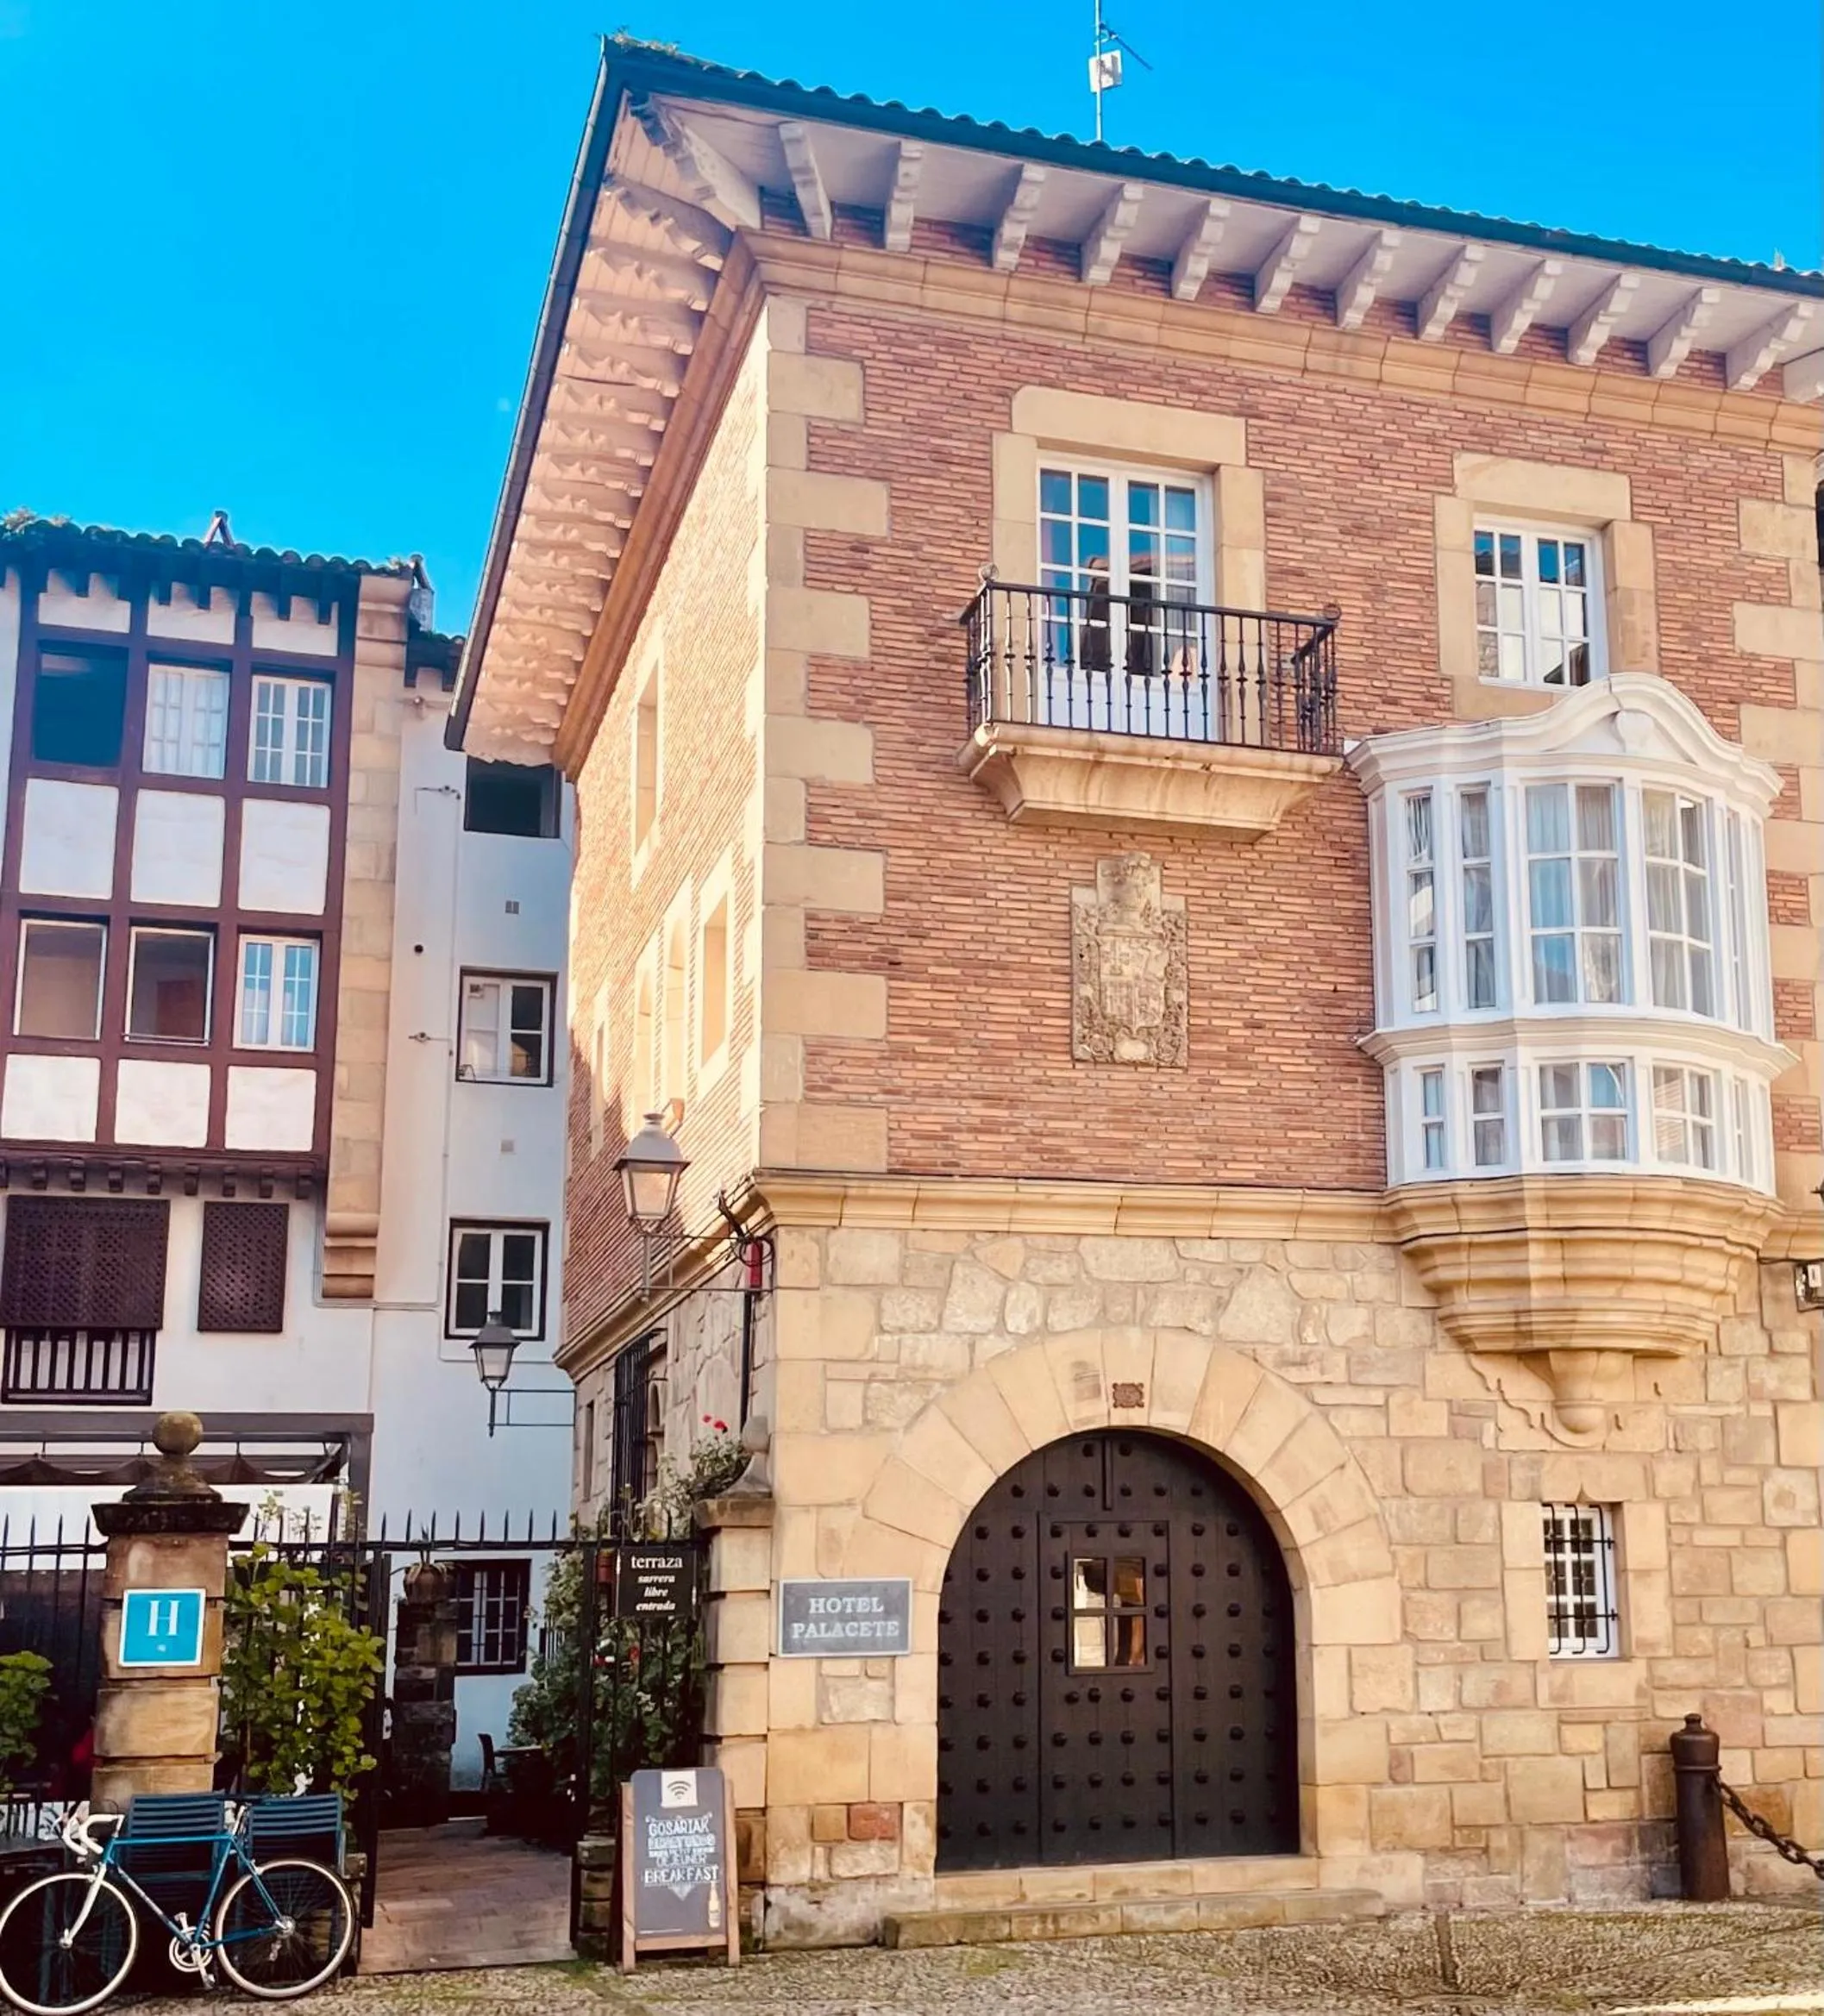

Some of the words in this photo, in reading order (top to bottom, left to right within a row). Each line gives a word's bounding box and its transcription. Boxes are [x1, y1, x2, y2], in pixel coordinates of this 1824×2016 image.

[630, 1555, 683, 1569] terraza
[636, 1600, 676, 1611] entrada
[808, 1597, 884, 1614] HOTEL
[147, 1600, 181, 1637] H
[792, 1621, 899, 1638] PALACETE
[644, 1863, 719, 1884] BREAKFAST
